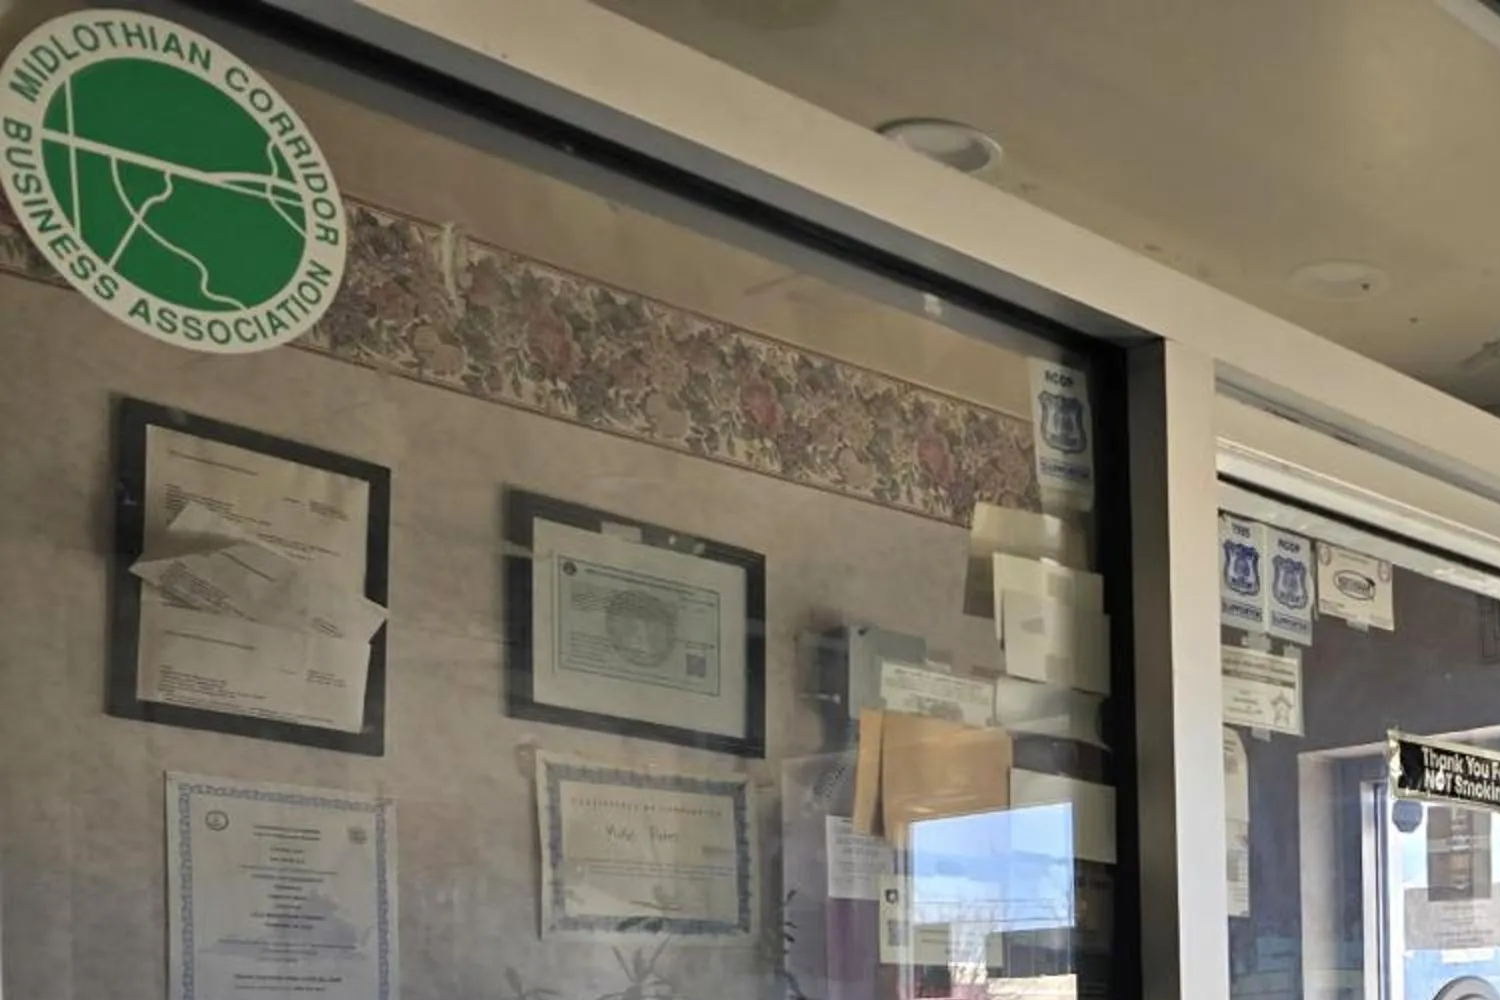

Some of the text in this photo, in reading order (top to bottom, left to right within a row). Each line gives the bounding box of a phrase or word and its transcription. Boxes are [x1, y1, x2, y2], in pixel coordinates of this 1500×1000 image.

[9, 21, 339, 247] MIDLOTHIAN CORRIDOR
[3, 116, 332, 346] BUSINESS ASSOCIATION
[1421, 746, 1465, 774] Thank
[1465, 755, 1490, 779] You
[1423, 768, 1452, 792] NOT
